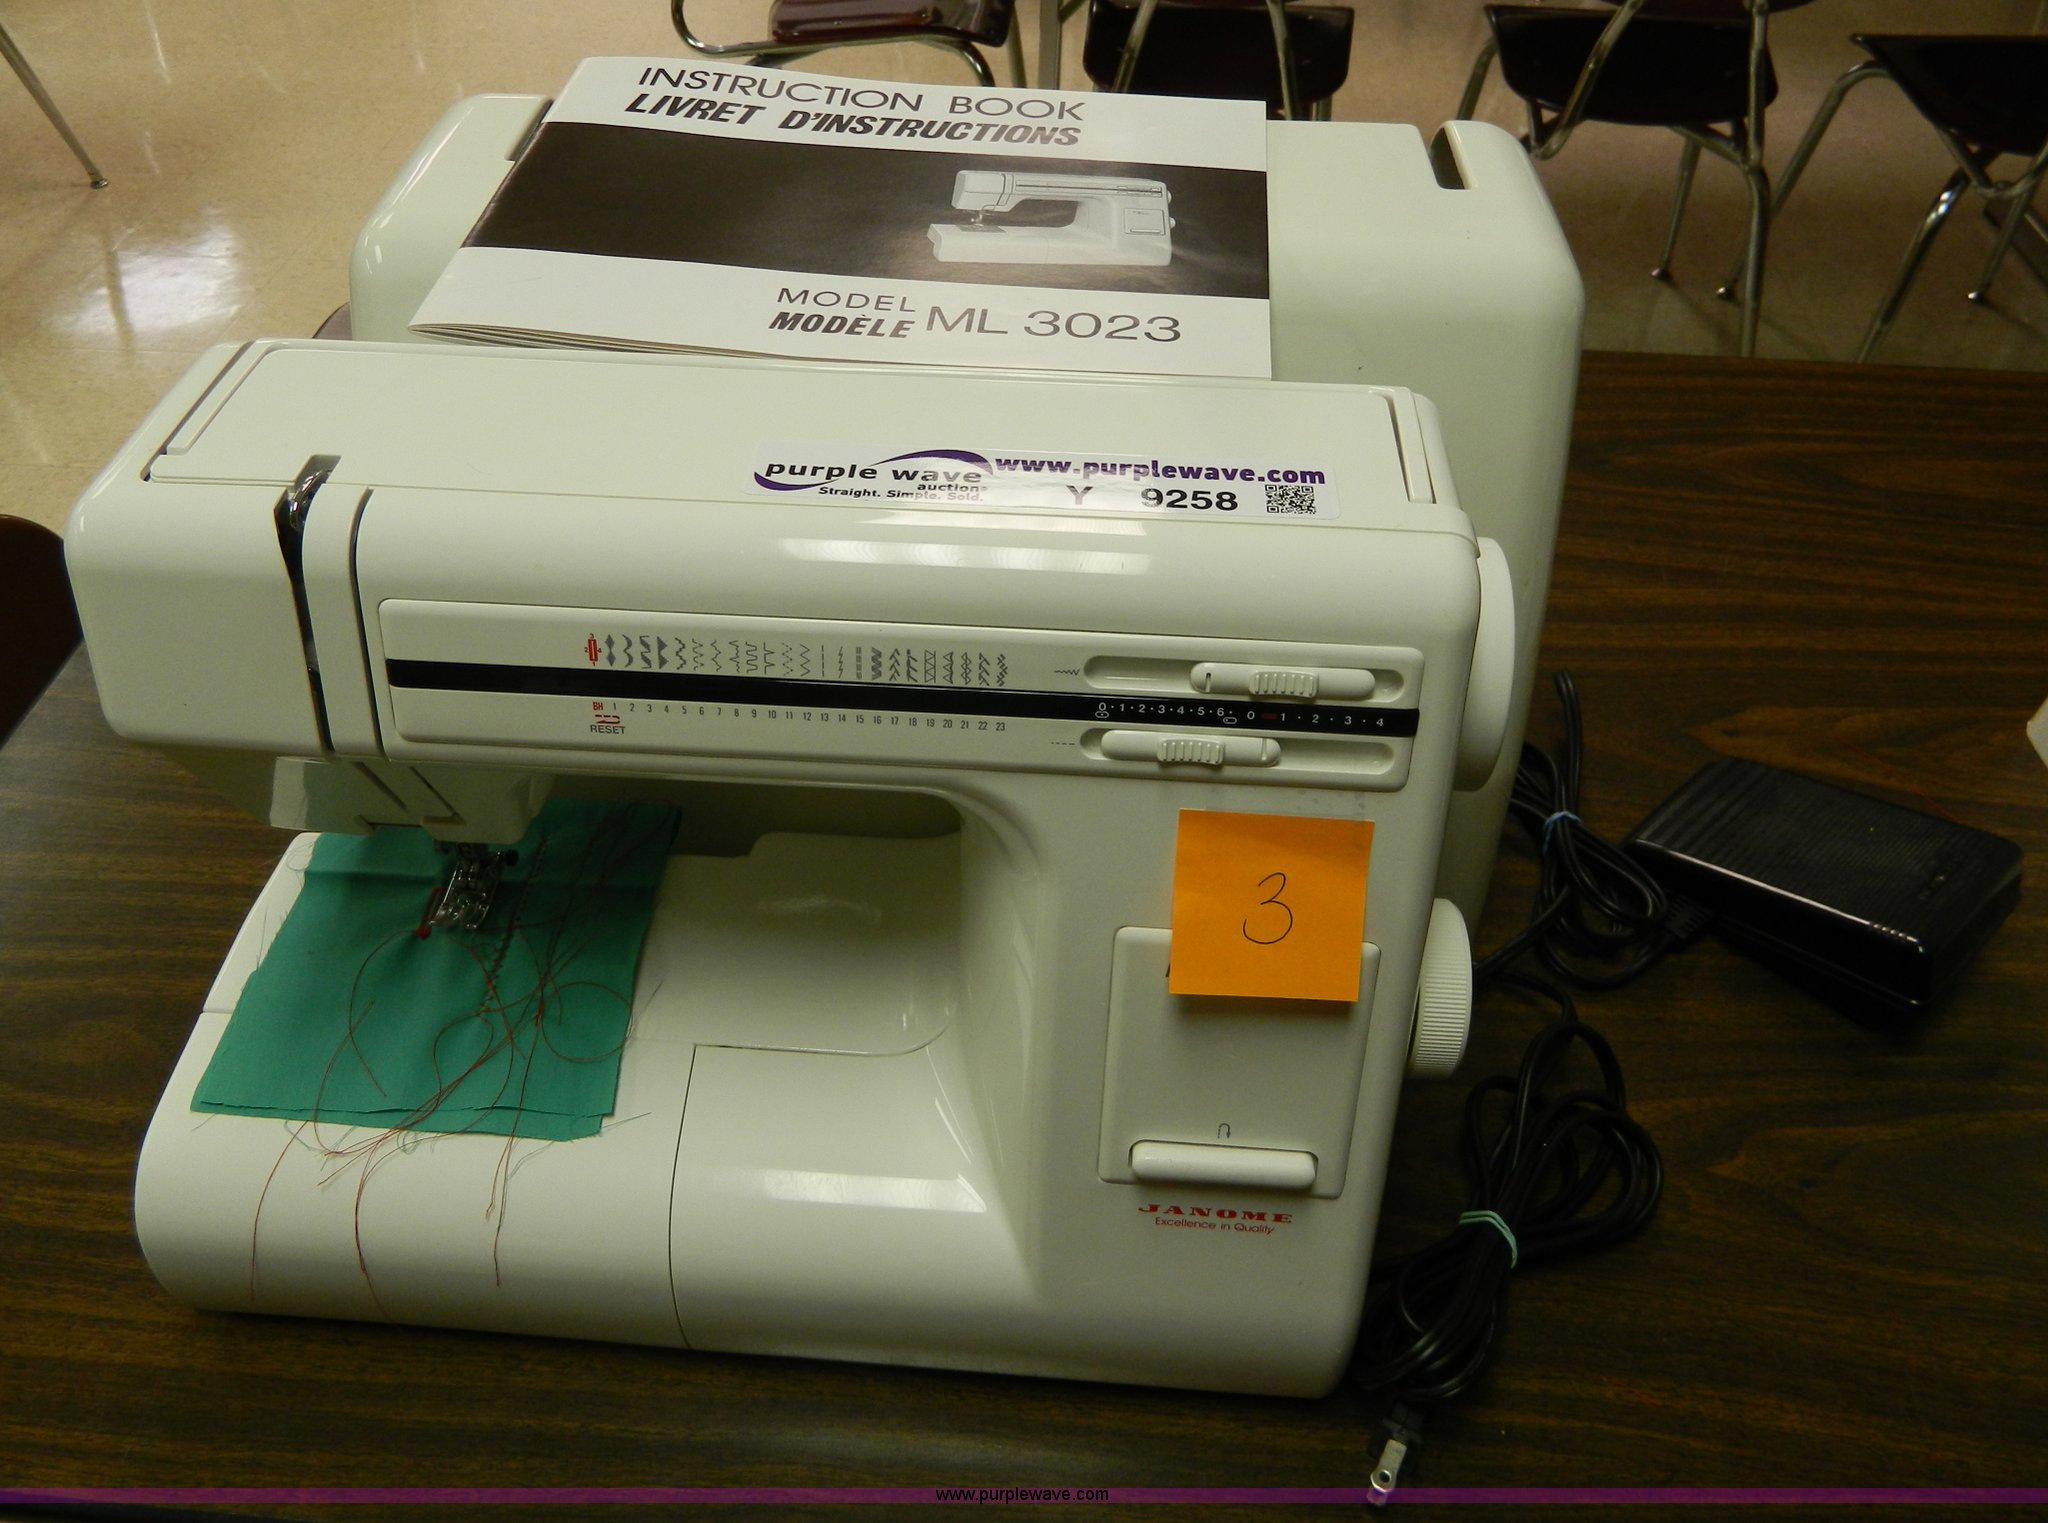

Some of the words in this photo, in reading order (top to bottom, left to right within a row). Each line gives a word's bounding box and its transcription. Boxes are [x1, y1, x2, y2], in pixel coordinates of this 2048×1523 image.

[638, 67, 924, 112] INSTRUCTION
[948, 95, 1087, 121] BOOK
[624, 93, 767, 125] LIVRET
[777, 109, 1082, 146] D'INSTRUCTIONS
[776, 287, 917, 313] MODEL
[767, 311, 917, 339] MODÈLE
[925, 305, 1009, 336] ML
[1023, 309, 1182, 343] 3023
[764, 463, 878, 481] purple
[891, 467, 982, 483] wave
[995, 457, 1326, 485] www.purplewave.com
[818, 486, 881, 499] Straight.
[886, 489, 941, 501] Simple.
[947, 491, 984, 502] Sold.
[1066, 485, 1094, 506] Y
[1140, 486, 1239, 512] 9258
[590, 724, 626, 735] RESET
[592, 701, 604, 711] BH
[630, 703, 635, 712] 2
[648, 704, 653, 713] 3
[664, 704, 669, 714] 4
[682, 705, 687, 714] 5
[699, 706, 704, 715] 6
[717, 707, 722, 716] 7
[734, 708, 740, 718] 8
[752, 709, 757, 718] 9
[768, 710, 777, 719] 10
[786, 711, 794, 720] 11
[803, 711, 812, 721] 12
[821, 712, 829, 722] 13
[838, 713, 847, 723] 14
[856, 714, 865, 724] 15
[873, 715, 882, 725] 16
[891, 716, 899, 726] 17
[908, 717, 918, 727] 18
[926, 718, 935, 728] 19
[943, 719, 953, 729] 20
[960, 720, 969, 730] 21
[978, 721, 988, 731] 22
[996, 722, 1006, 732] 23
[1243, 872, 1294, 945] 3
[1137, 1203, 1294, 1224] JANOME
[1154, 1216, 1217, 1230] Excellence
[1220, 1221, 1231, 1231] in
[1233, 1223, 1276, 1236] Quality
